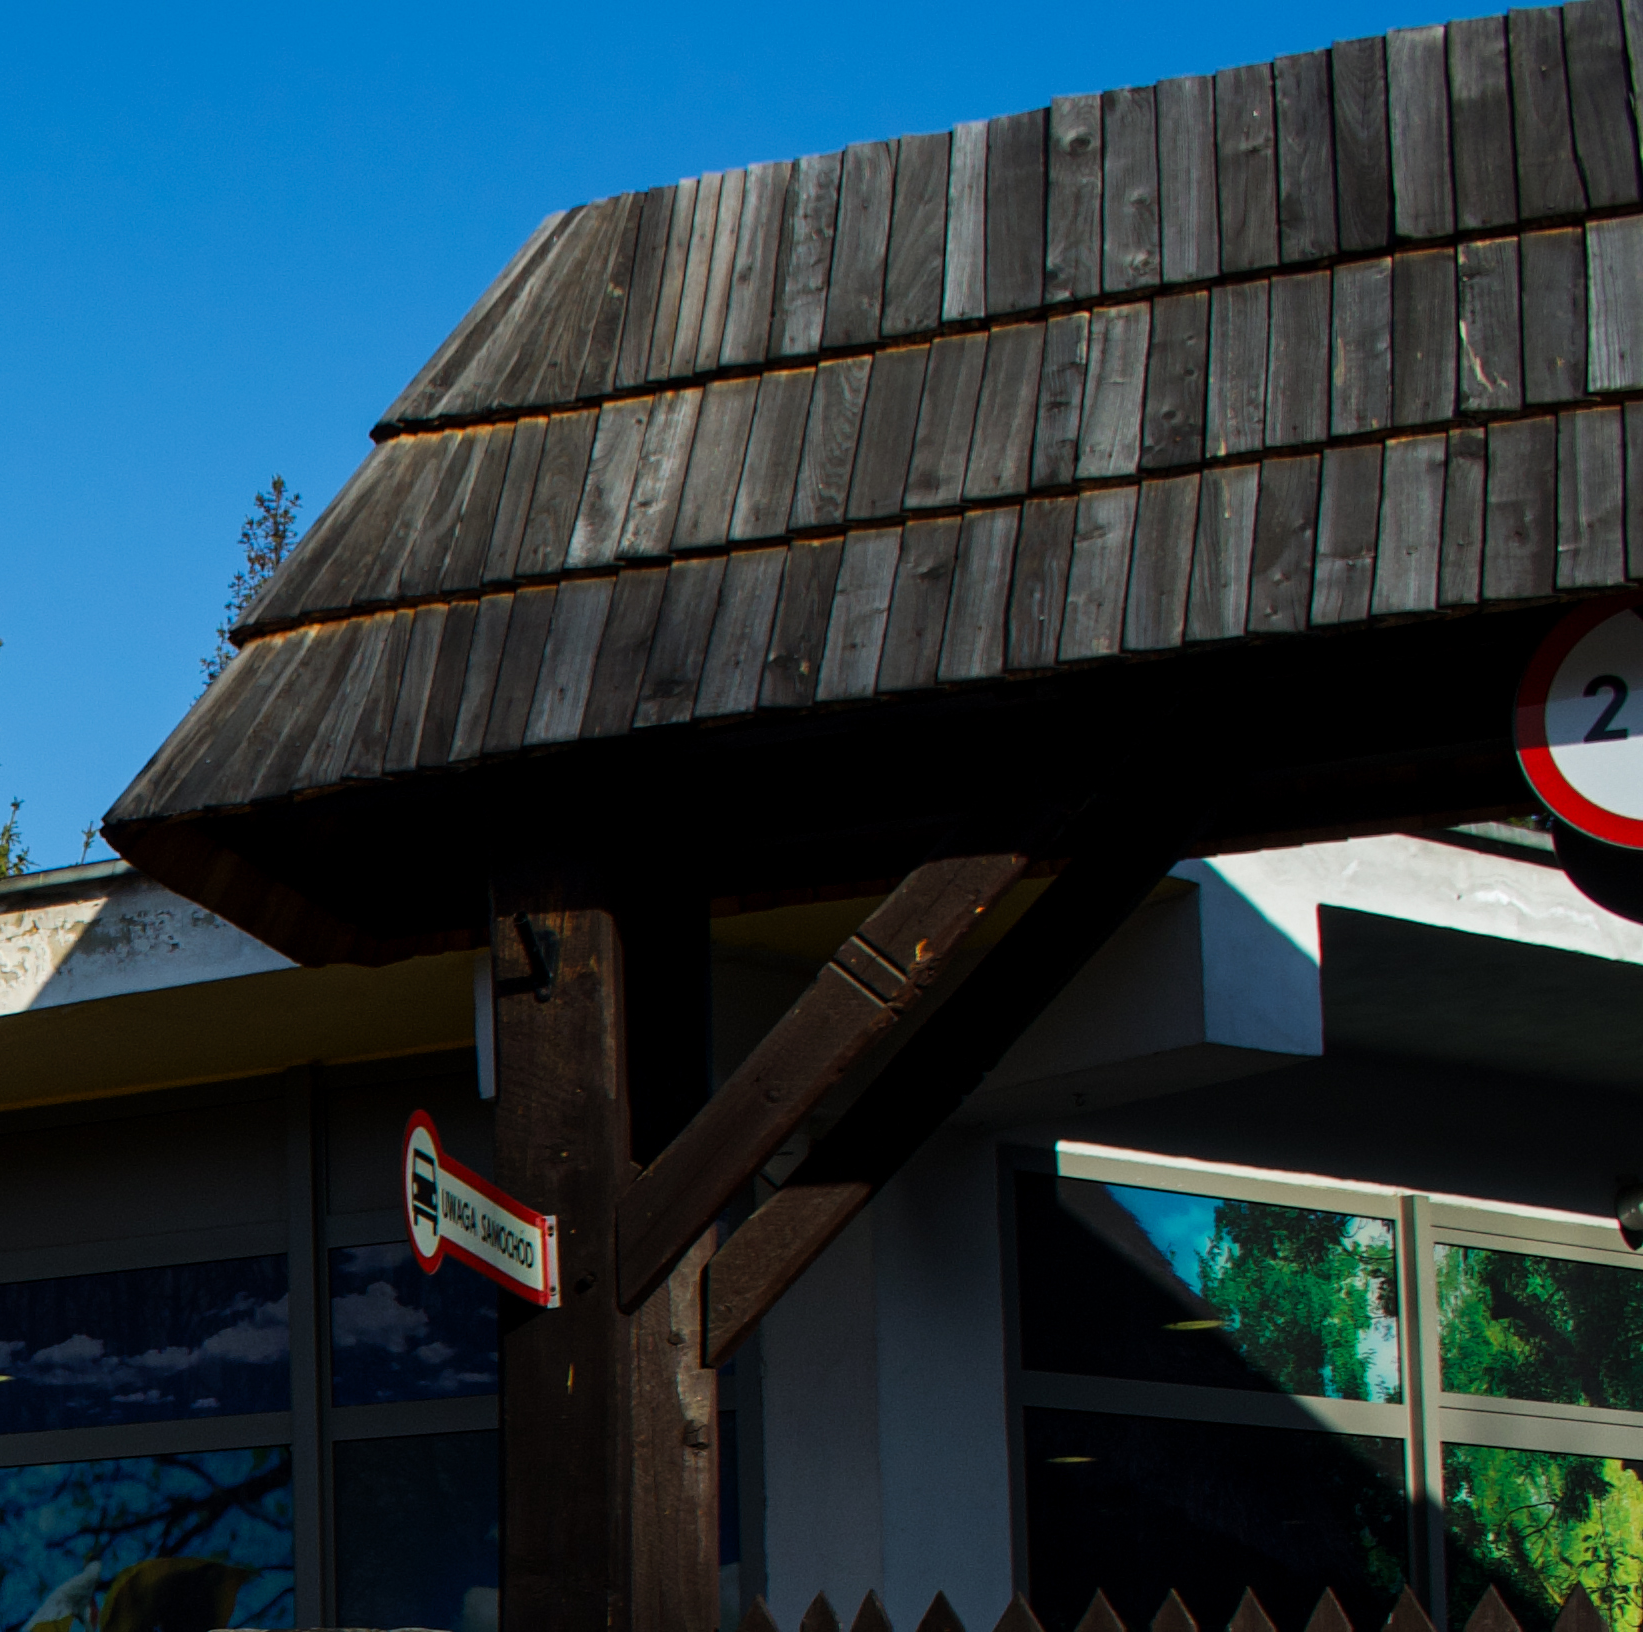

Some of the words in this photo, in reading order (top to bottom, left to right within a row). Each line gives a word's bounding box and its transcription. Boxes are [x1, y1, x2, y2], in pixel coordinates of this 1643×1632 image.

[1582, 674, 1629, 743] 2
[441, 1188, 477, 1237] UWAGA
[481, 1213, 534, 1269] SAMOCHÓD
